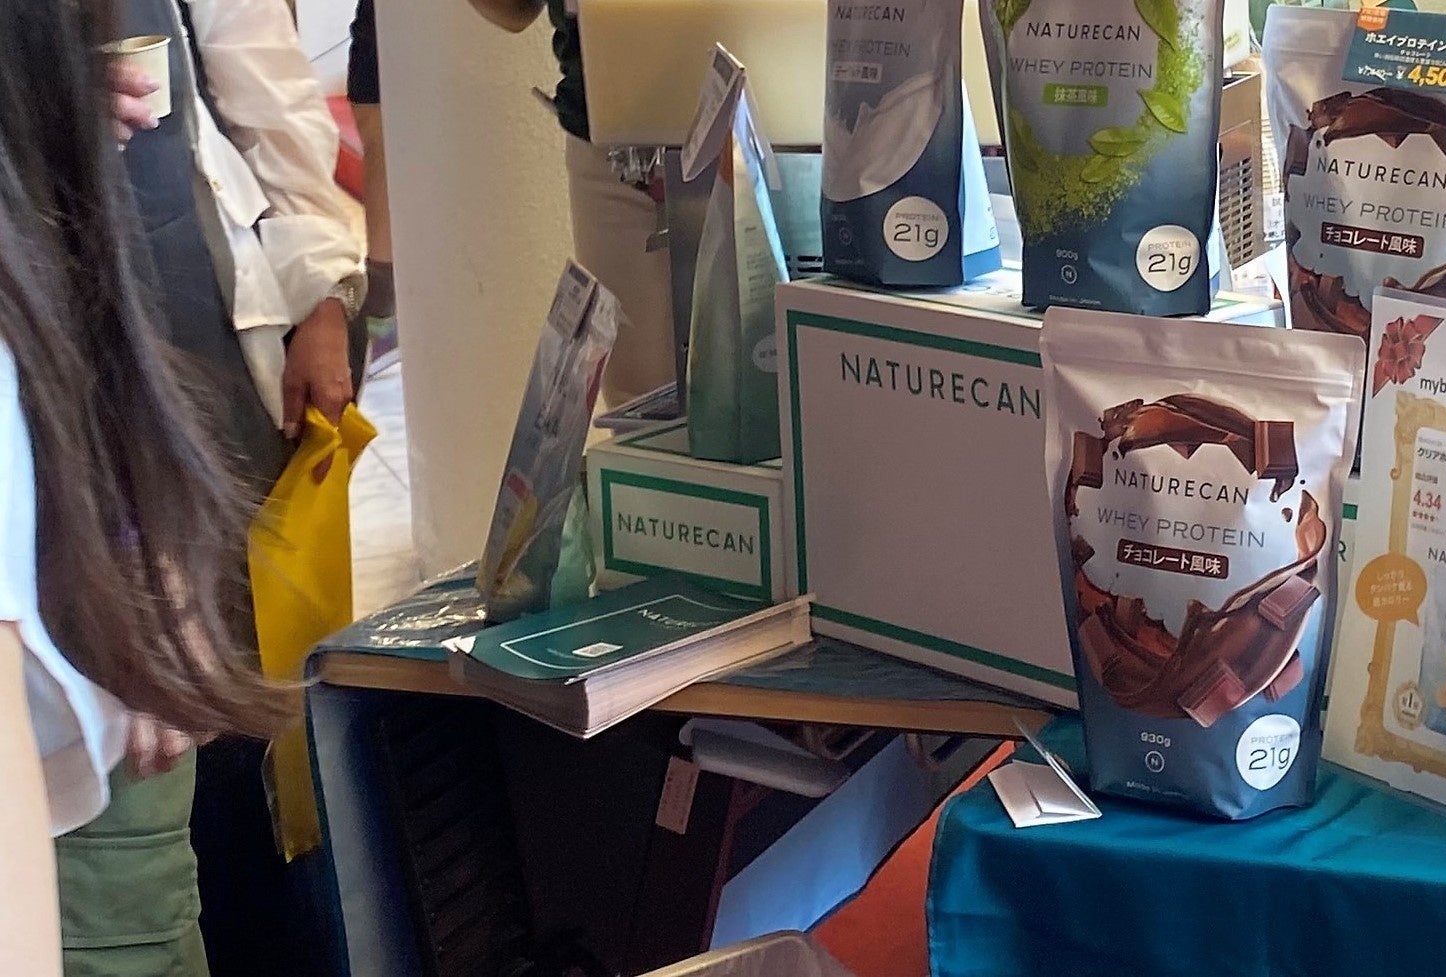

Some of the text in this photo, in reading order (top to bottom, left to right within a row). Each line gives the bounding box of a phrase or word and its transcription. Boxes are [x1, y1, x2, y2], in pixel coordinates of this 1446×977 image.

[1026, 22, 1140, 41] NATURECAN
[1010, 58, 1152, 78] WHEY PROTEIN
[1303, 193, 1353, 214] WHEY
[893, 223, 939, 248] 21g
[1148, 240, 1192, 251] PROTEIN
[1324, 226, 1417, 255] チョコレート風味
[1148, 253, 1192, 274] 21g
[840, 352, 1041, 420] NATURECAN
[1115, 469, 1249, 505] NATURECAN
[1413, 489, 1442, 510] 4.34
[617, 511, 755, 556] NATURECAN
[1097, 507, 1265, 548] WHEY PROTEIN
[1122, 542, 1222, 576] チョコレート風味
[1140, 731, 1171, 747] 930g
[1248, 746, 1291, 771] 21g
